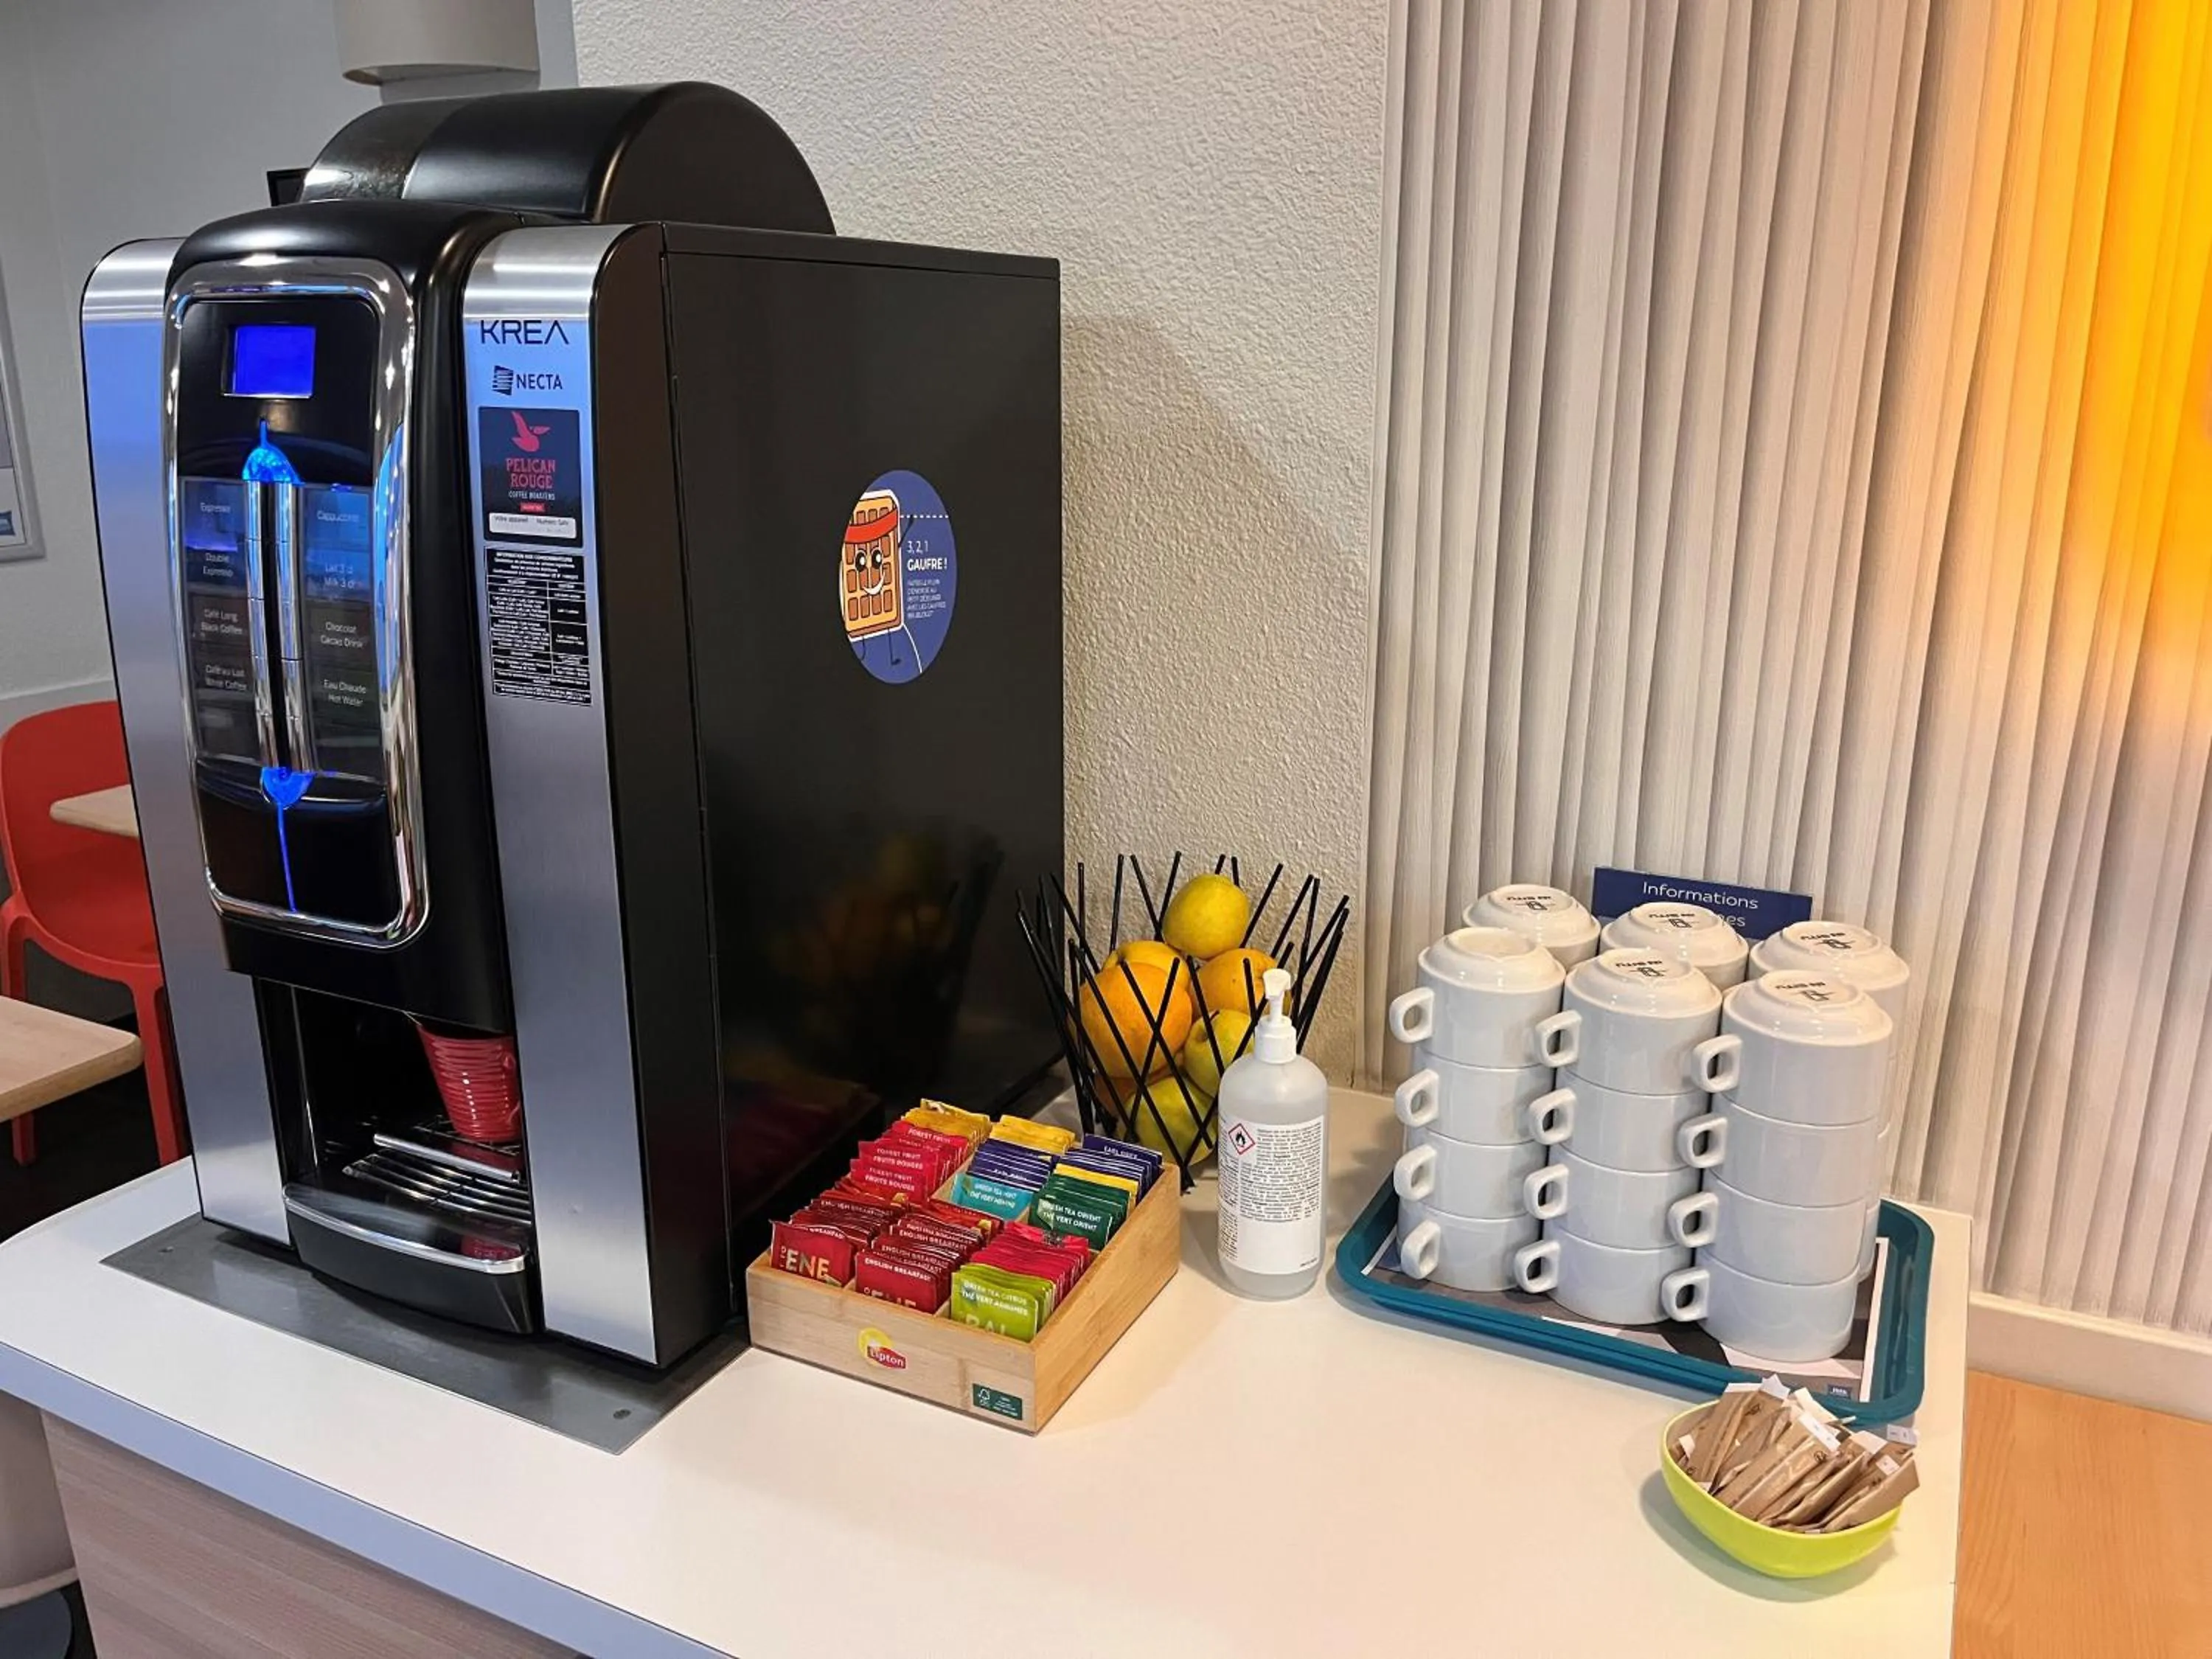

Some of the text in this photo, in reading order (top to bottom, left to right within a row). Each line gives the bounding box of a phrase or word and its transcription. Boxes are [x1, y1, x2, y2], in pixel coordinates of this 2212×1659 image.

[481, 320, 569, 344] KREA
[517, 374, 563, 389] NECTA
[506, 458, 556, 473] PELICAN
[511, 473, 553, 488] ROUGE
[1643, 881, 1759, 909] Informations
[865, 1174, 915, 1192] FRUITS ROUGES
[1055, 1214, 1072, 1225] VERT
[1073, 1220, 1098, 1232] ORIENT
[1064, 1207, 1076, 1217] TEA
[1077, 1211, 1102, 1223] ORIENT
[899, 1229, 967, 1251] ENGLISH BREAKFAST
[865, 1257, 932, 1281] ENGLISH BREAKFAST
[870, 1346, 903, 1367] Lipton
